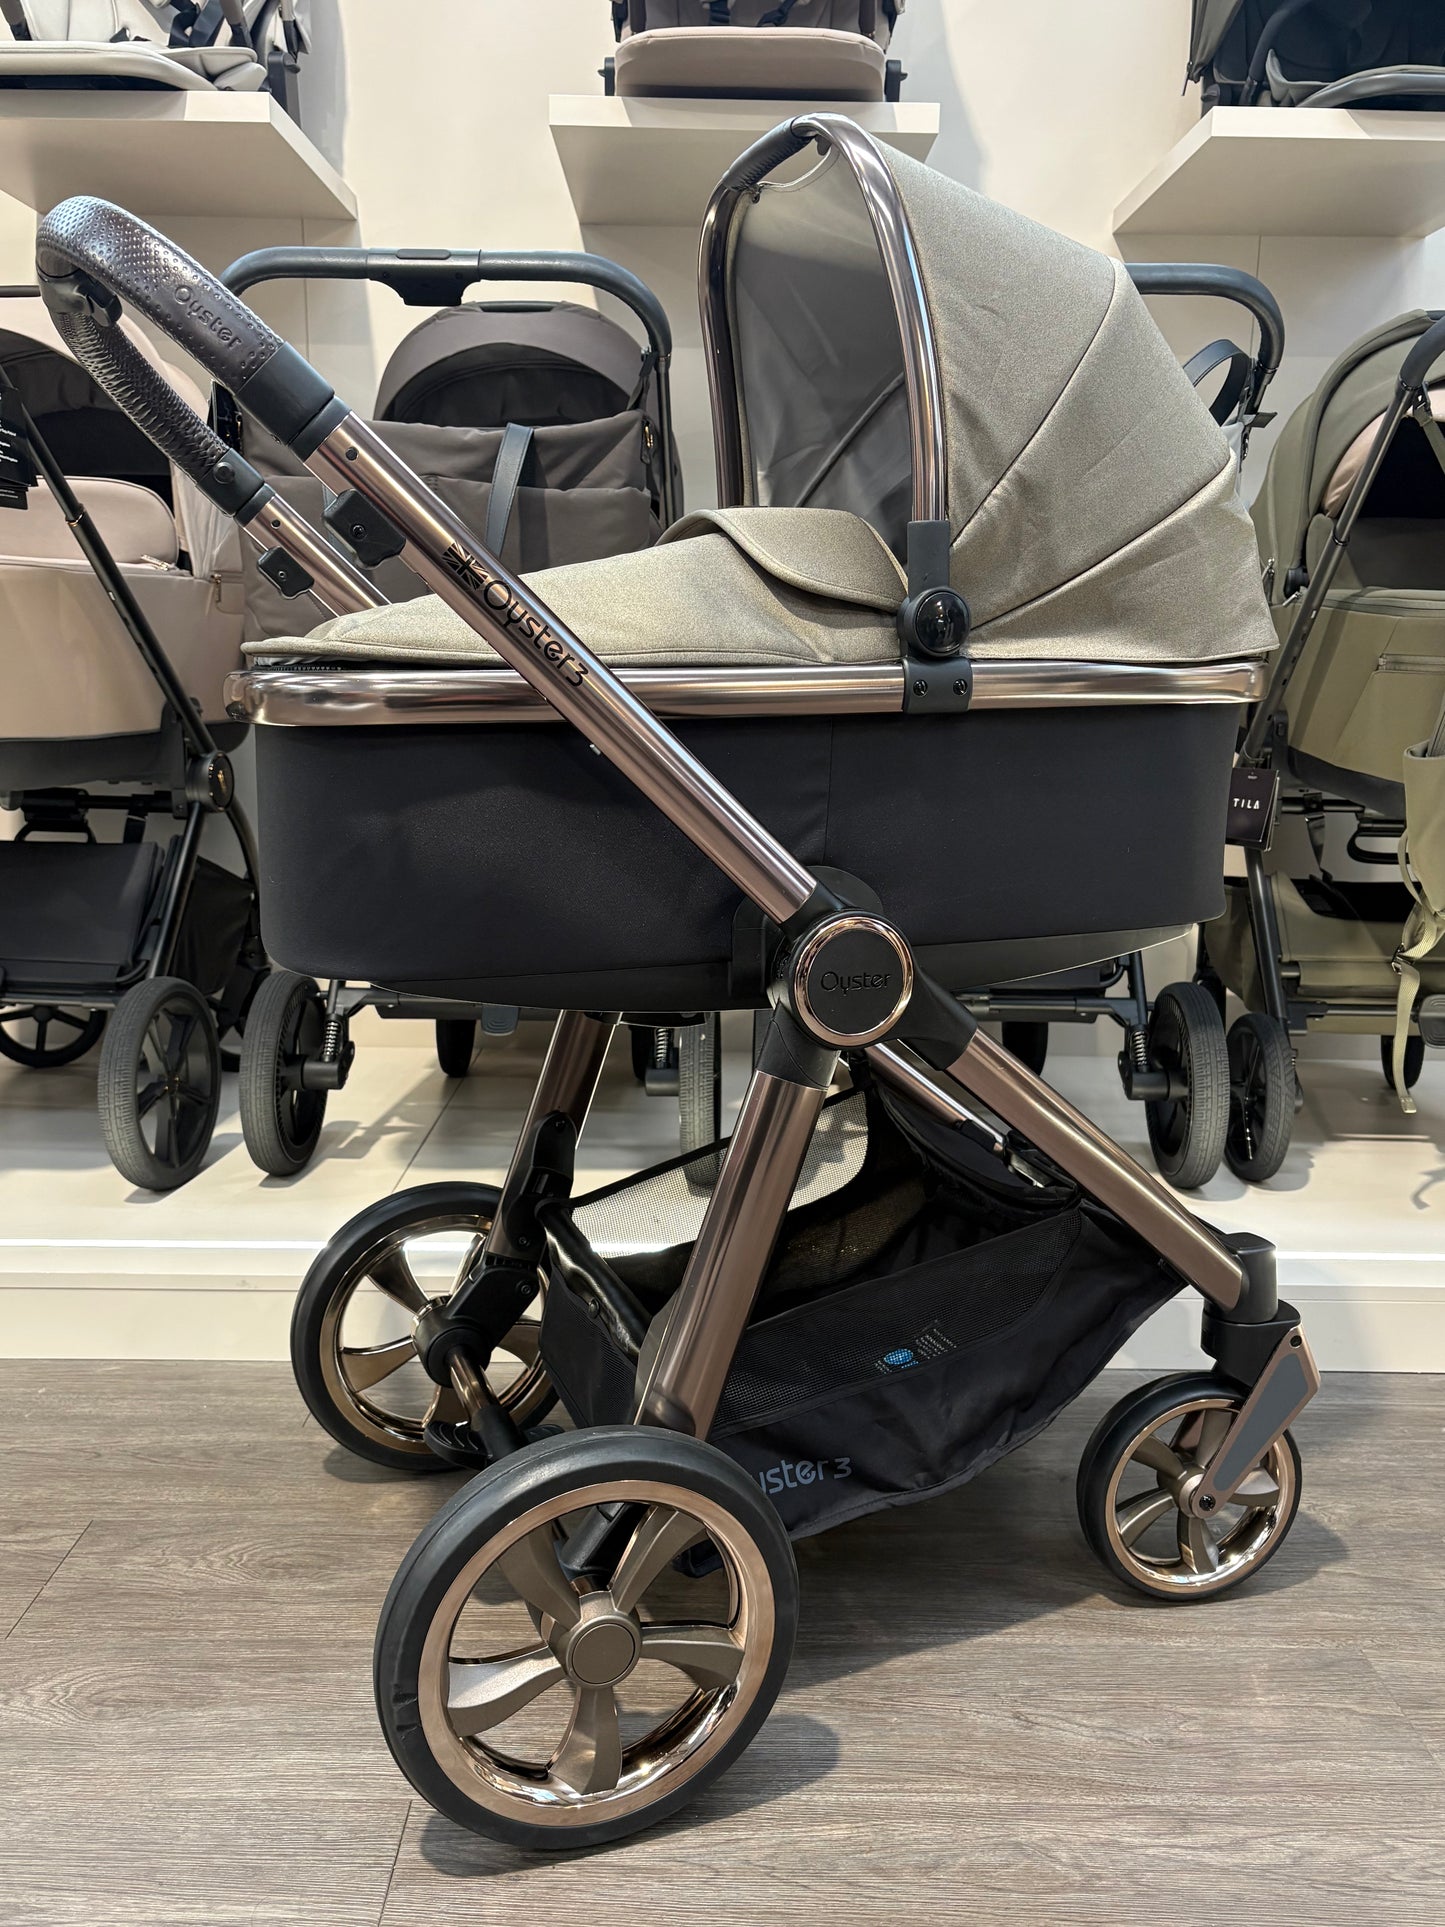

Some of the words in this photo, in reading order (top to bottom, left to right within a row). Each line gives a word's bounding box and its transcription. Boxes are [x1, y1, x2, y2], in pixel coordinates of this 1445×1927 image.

[175, 285, 242, 349] Oyster
[1233, 797, 1260, 810] TILA
[820, 970, 892, 996] Oyster
